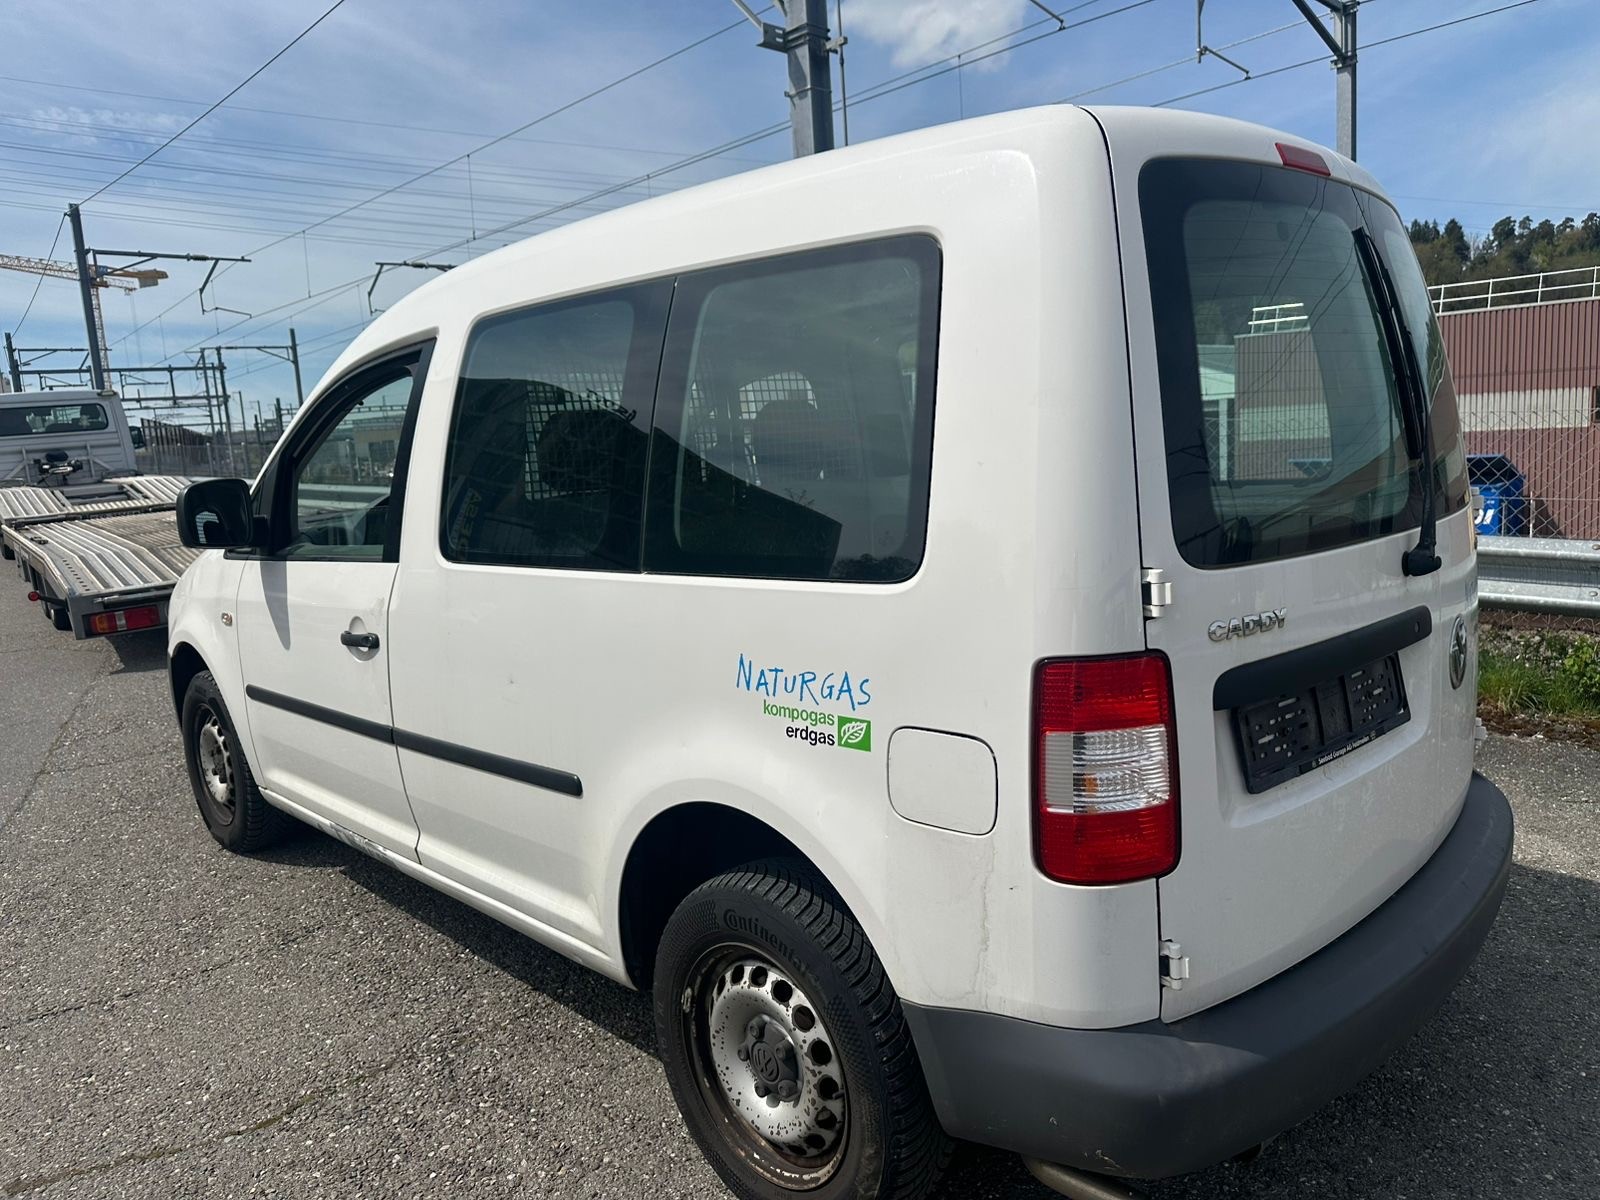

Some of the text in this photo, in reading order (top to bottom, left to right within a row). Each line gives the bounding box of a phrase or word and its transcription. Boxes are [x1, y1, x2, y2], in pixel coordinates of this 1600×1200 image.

[1208, 607, 1287, 642] CADDY
[736, 653, 871, 711] NATURGAS
[763, 699, 835, 726] kompogas
[786, 726, 835, 746] erdgas
